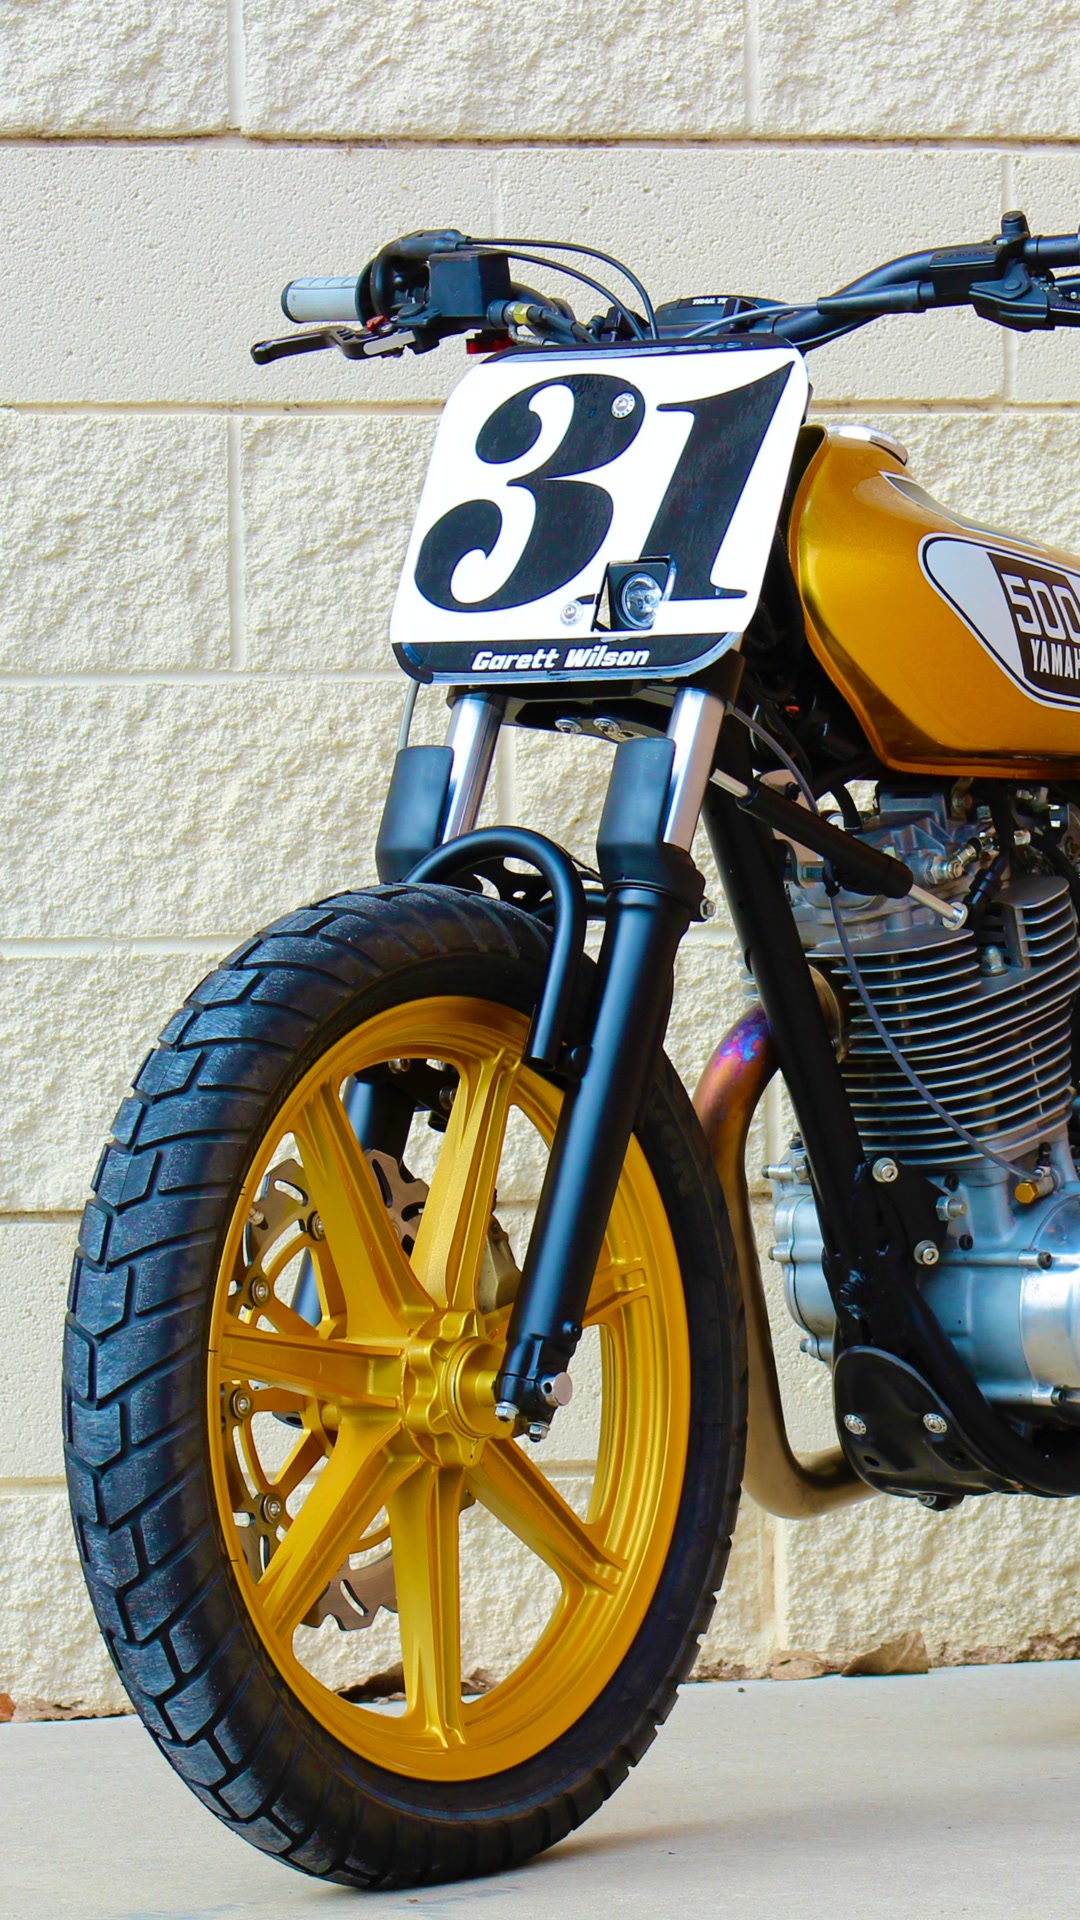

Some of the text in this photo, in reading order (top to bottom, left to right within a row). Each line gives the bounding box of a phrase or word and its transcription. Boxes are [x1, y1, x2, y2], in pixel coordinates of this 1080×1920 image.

[414, 361, 795, 613] 31
[1001, 573, 1080, 644] 500
[472, 645, 650, 671] Garett Wilson
